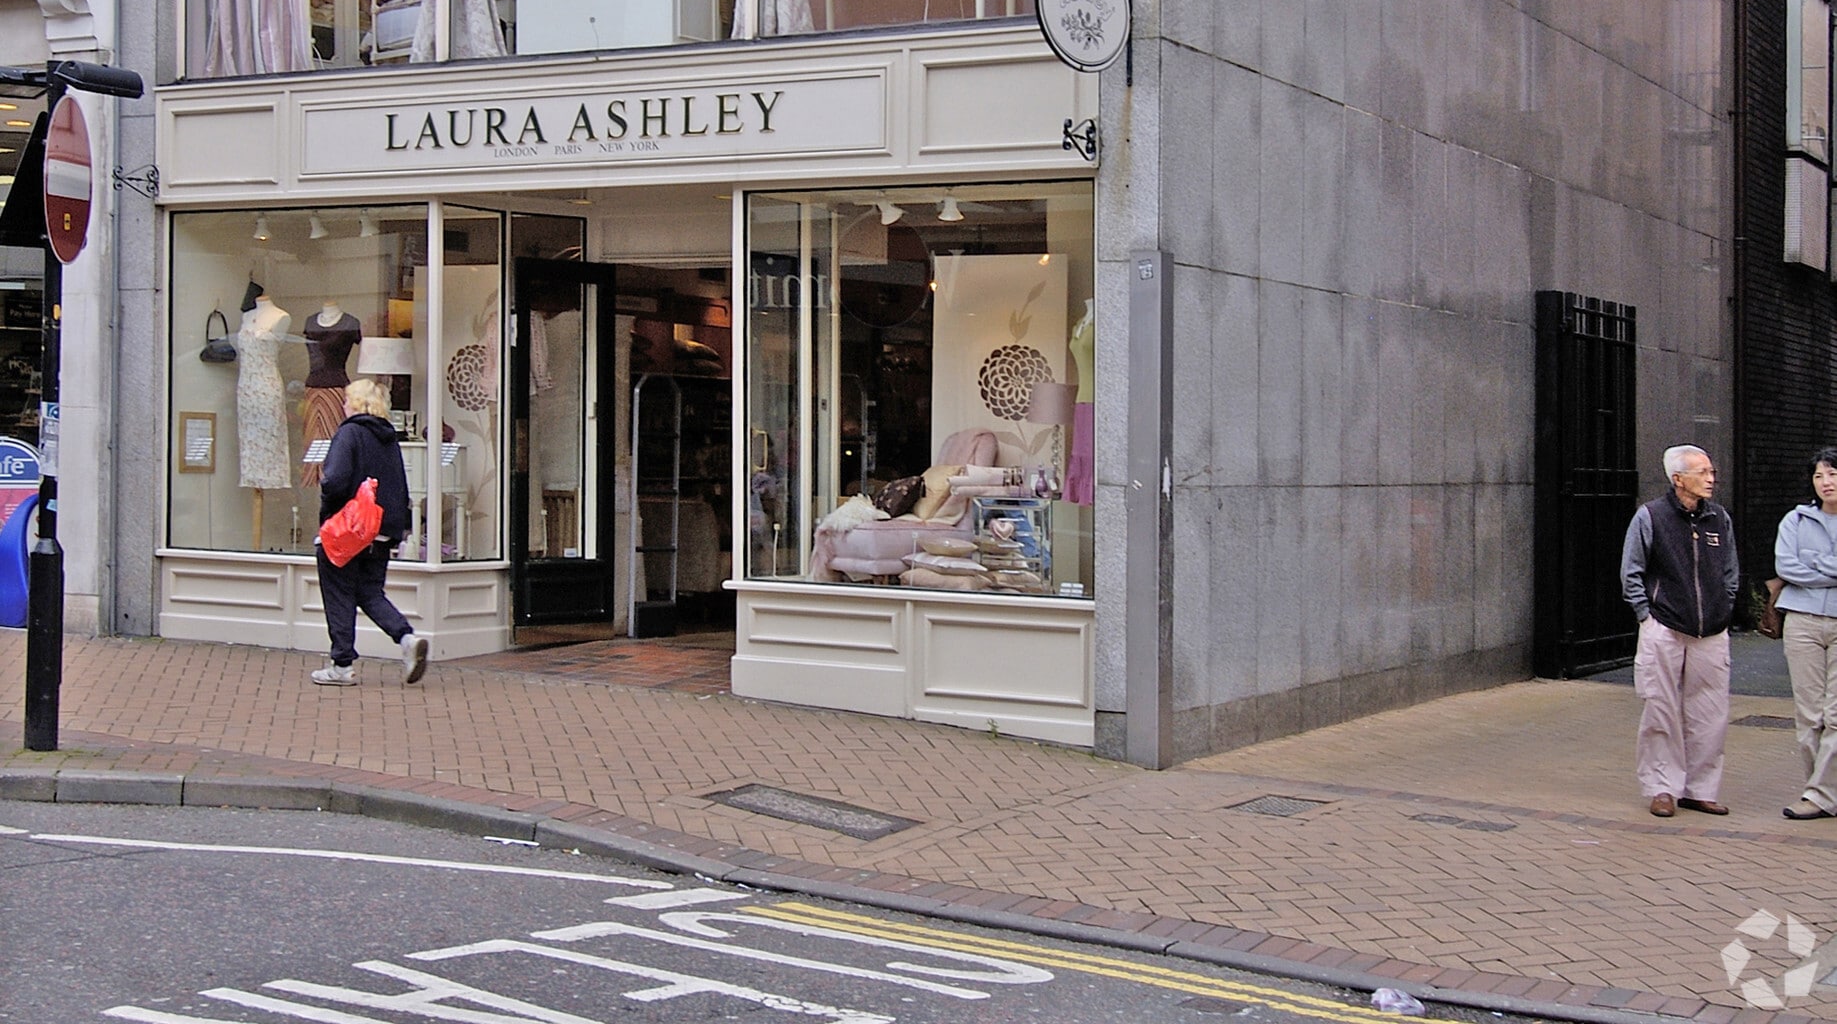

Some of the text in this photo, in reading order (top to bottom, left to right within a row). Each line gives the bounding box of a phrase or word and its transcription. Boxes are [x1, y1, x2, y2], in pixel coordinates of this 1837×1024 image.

[385, 91, 785, 151] LAURA ASHLEY
[494, 140, 660, 158] LONDON PARIS NEW YORK
[0, 455, 25, 475] fe
